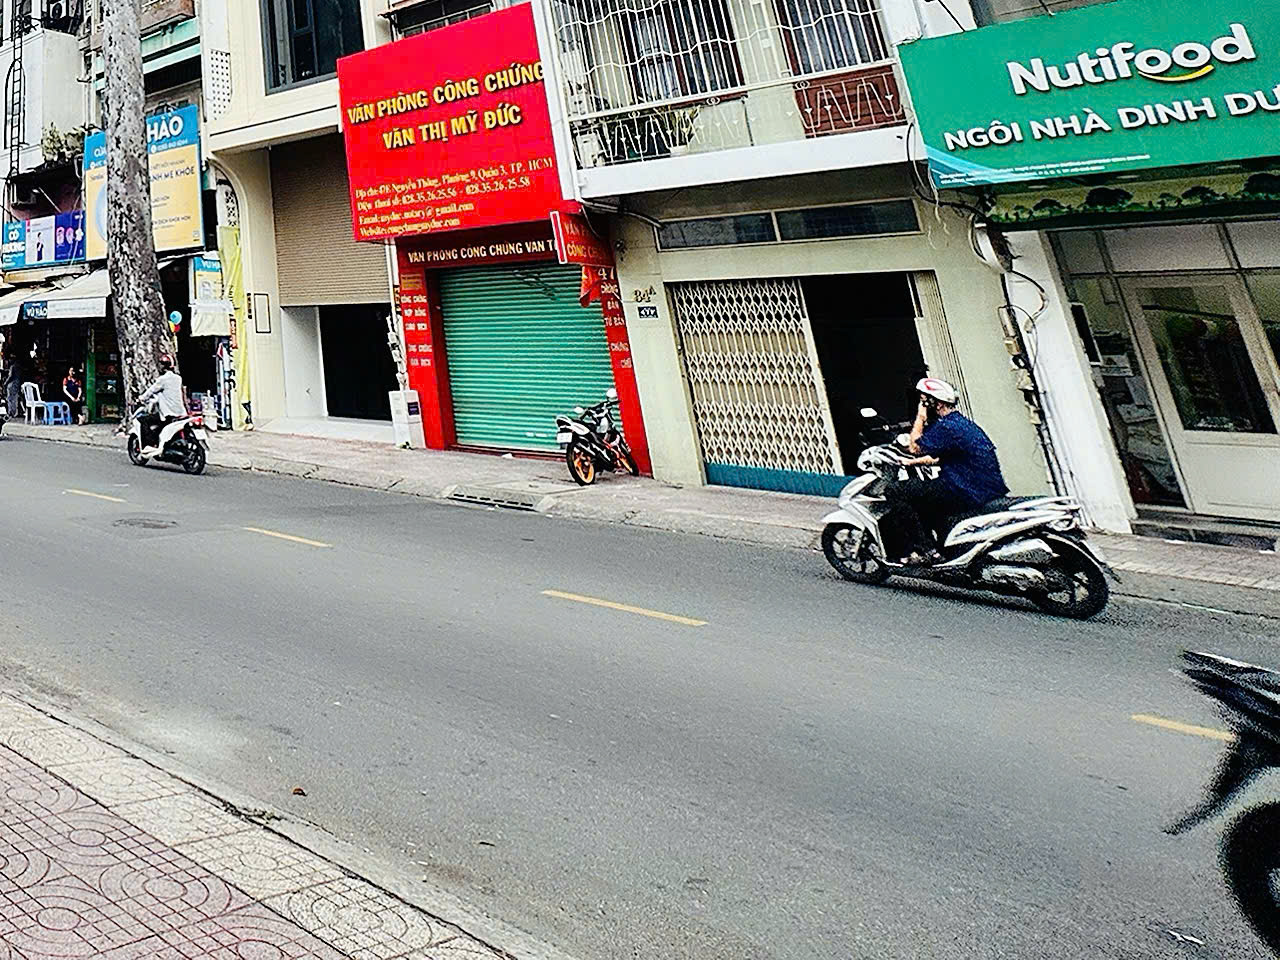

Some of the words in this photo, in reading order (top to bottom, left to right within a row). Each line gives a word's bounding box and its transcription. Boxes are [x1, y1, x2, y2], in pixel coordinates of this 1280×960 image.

[1006, 24, 1256, 95] Nutifood
[347, 100, 375, 124] VĂN
[377, 90, 429, 117] PHÒNG
[433, 78, 480, 104] CÔNG
[484, 61, 544, 92] CHỨNG
[382, 127, 415, 149] VĂN
[418, 120, 449, 142] THỊ
[450, 110, 478, 136] MỸ
[484, 102, 522, 129] ĐỨC
[943, 120, 1024, 151] NGÔI
[1031, 108, 1111, 140] NHÀ
[1118, 97, 1217, 129] DINH
